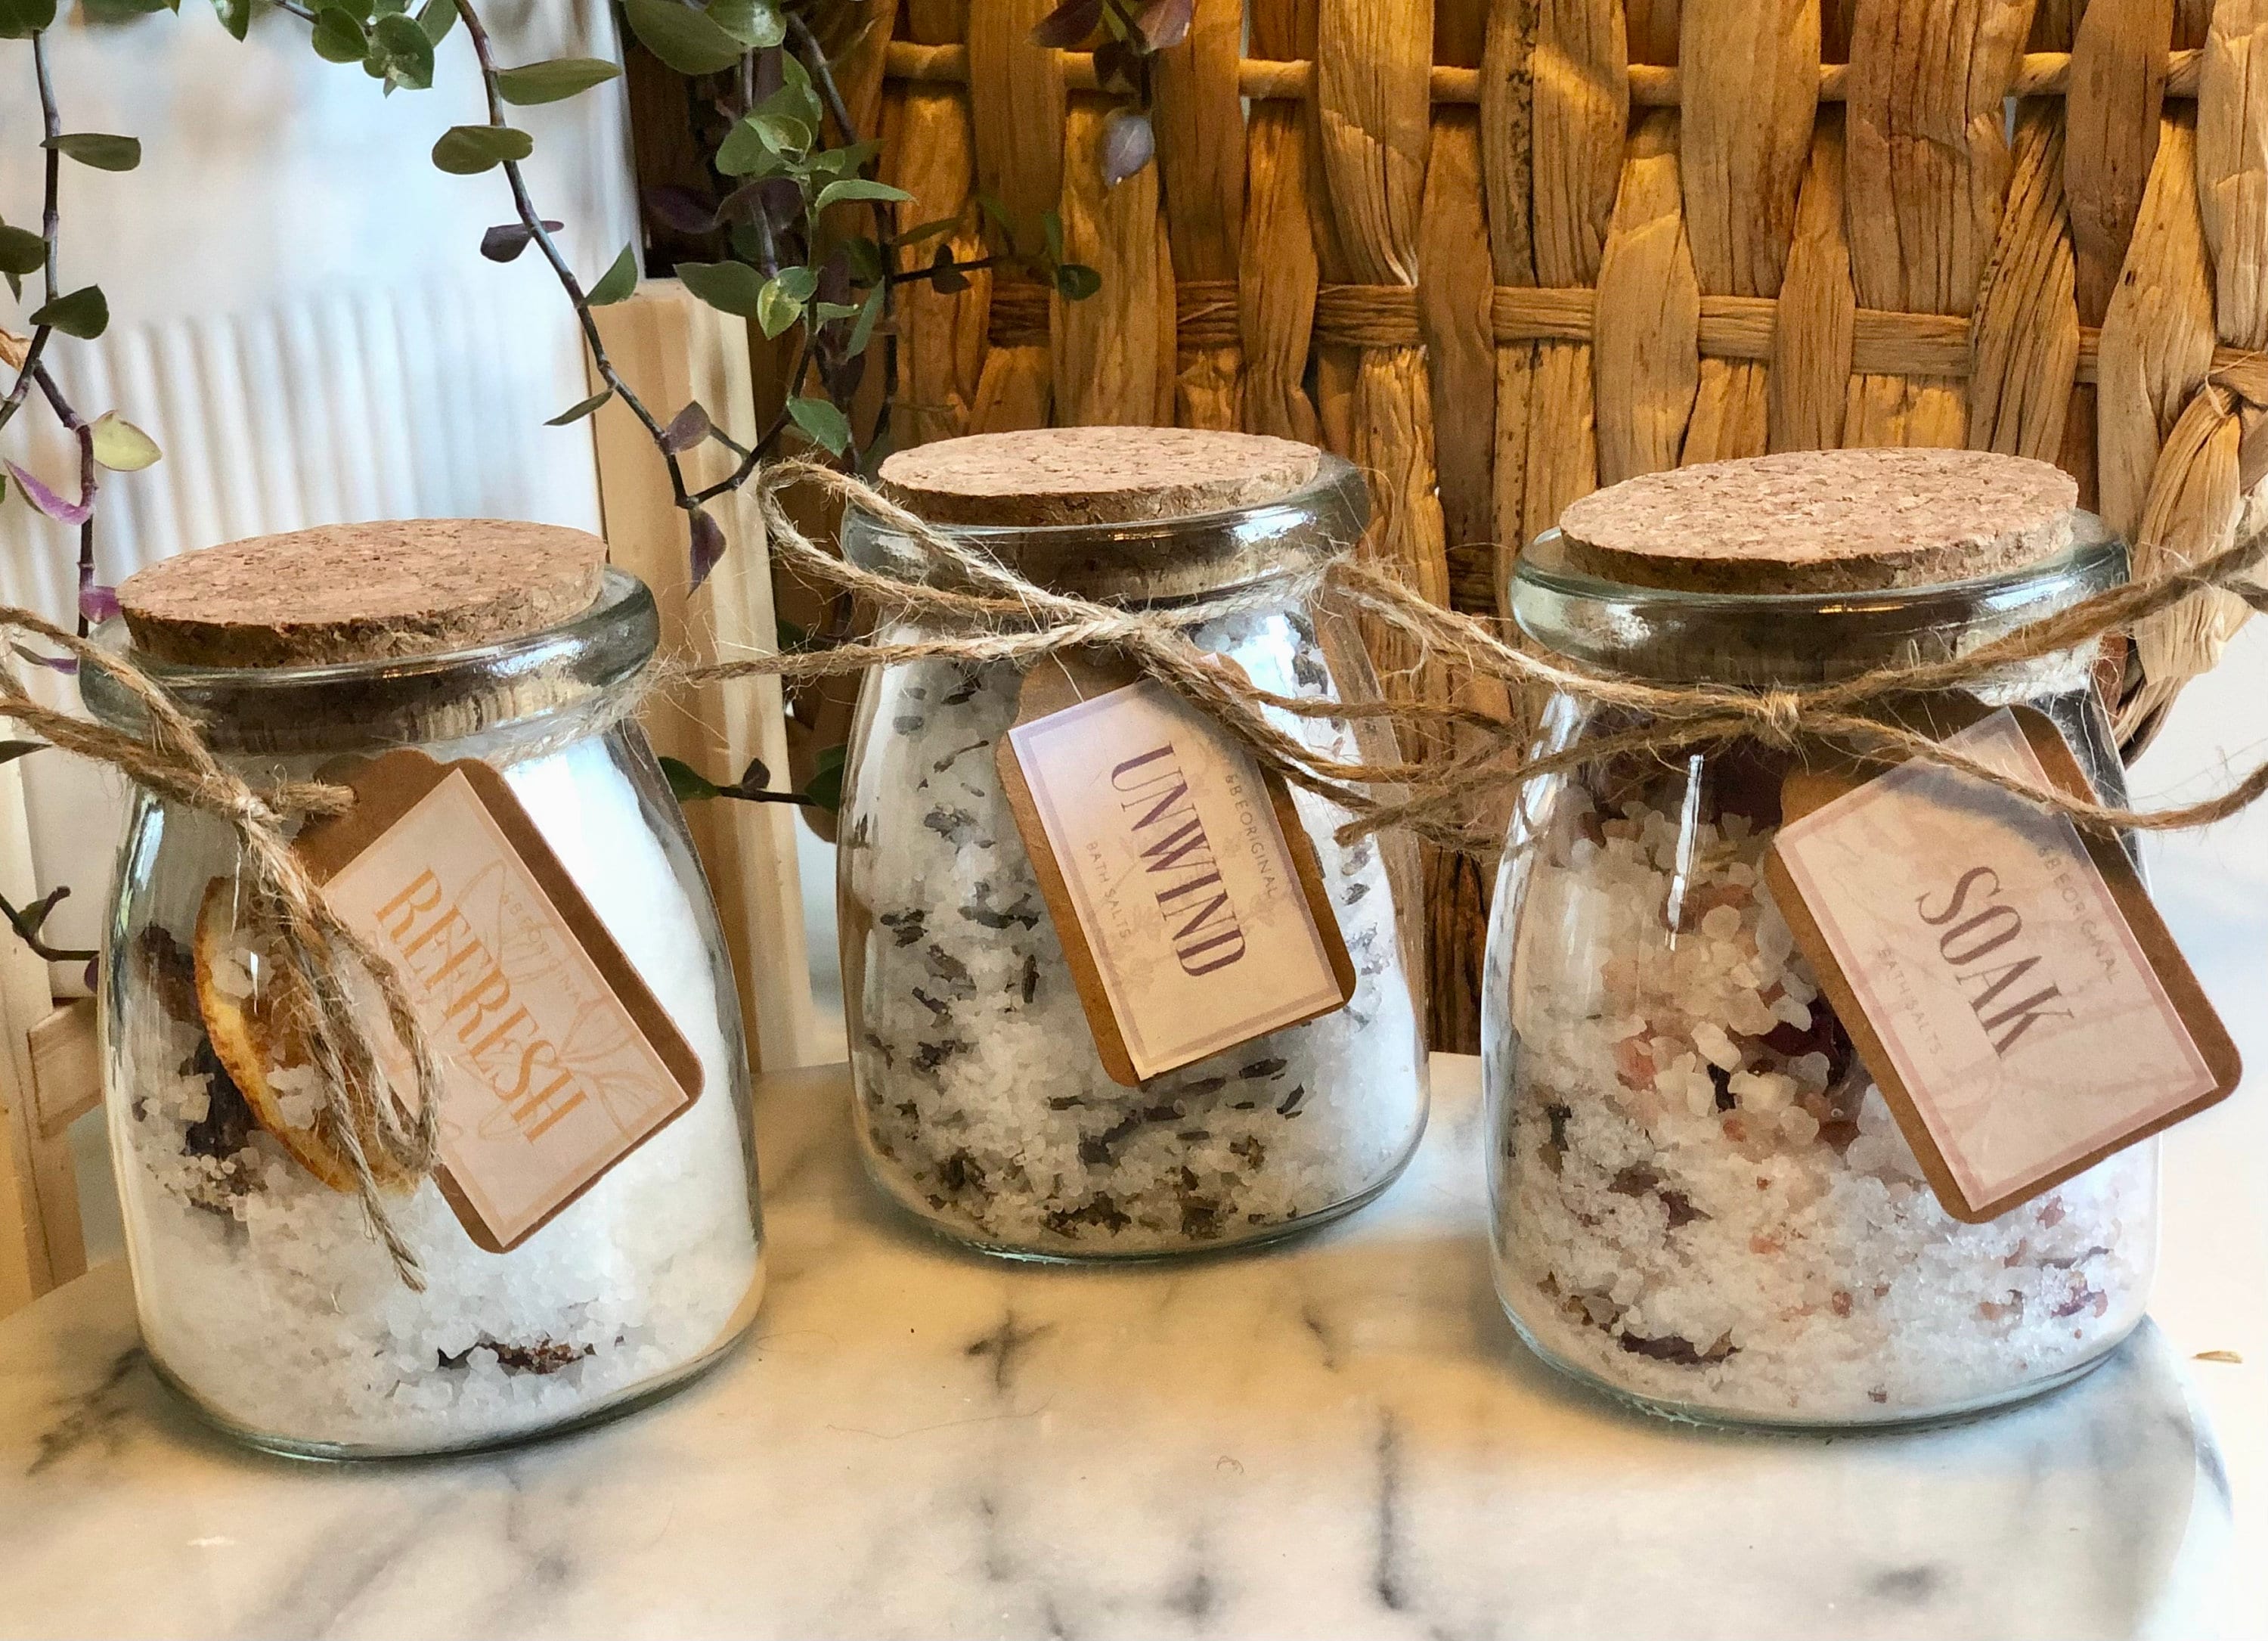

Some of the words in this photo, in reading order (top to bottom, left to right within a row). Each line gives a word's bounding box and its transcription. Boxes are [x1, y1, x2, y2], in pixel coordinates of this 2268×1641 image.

[1086, 841, 1109, 886] BATH
[1103, 888, 1132, 940] SALTS
[1111, 741, 1246, 977] UNWIND
[1915, 867, 2074, 1059] SOAK
[375, 869, 587, 1143] REFRESH
